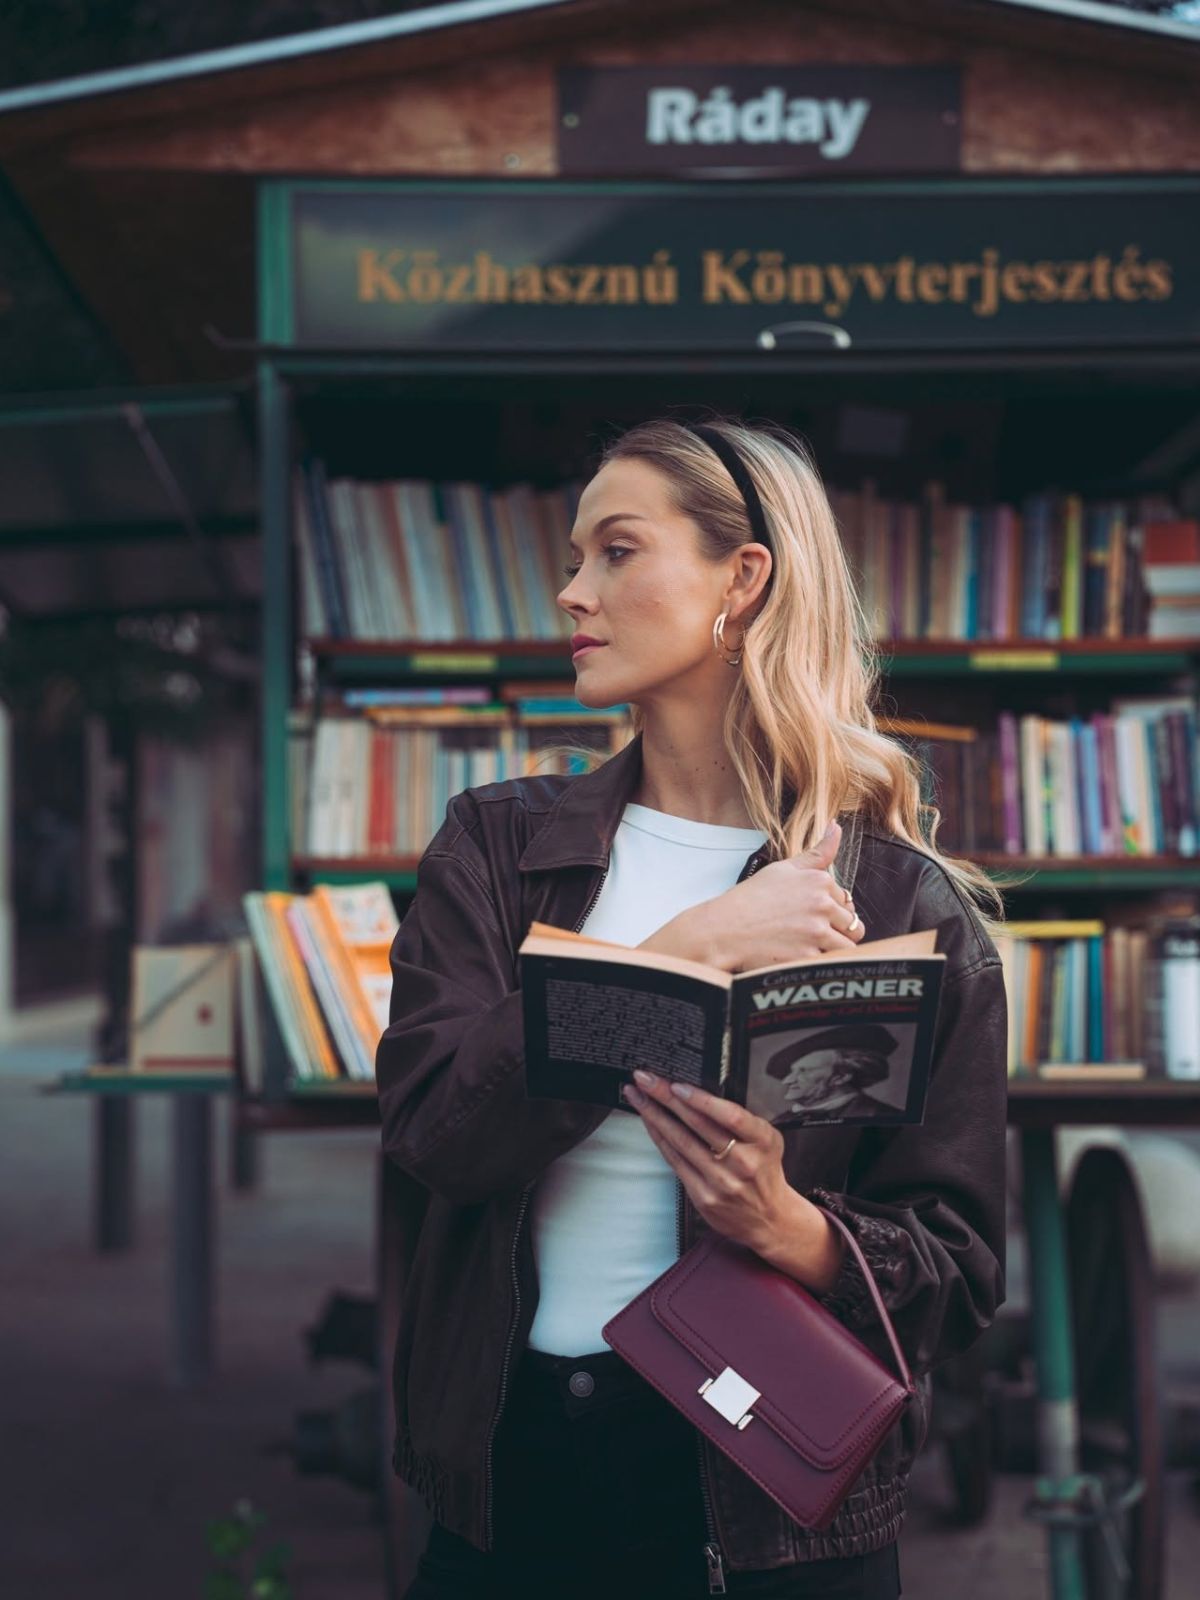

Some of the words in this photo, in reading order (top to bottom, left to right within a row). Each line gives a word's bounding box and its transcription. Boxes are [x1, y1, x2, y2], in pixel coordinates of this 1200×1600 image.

[647, 86, 869, 159] Ráday
[358, 249, 678, 304] Közhasznú
[703, 245, 1173, 317] Könyvterjesztés
[752, 978, 923, 1011] WAGNER
